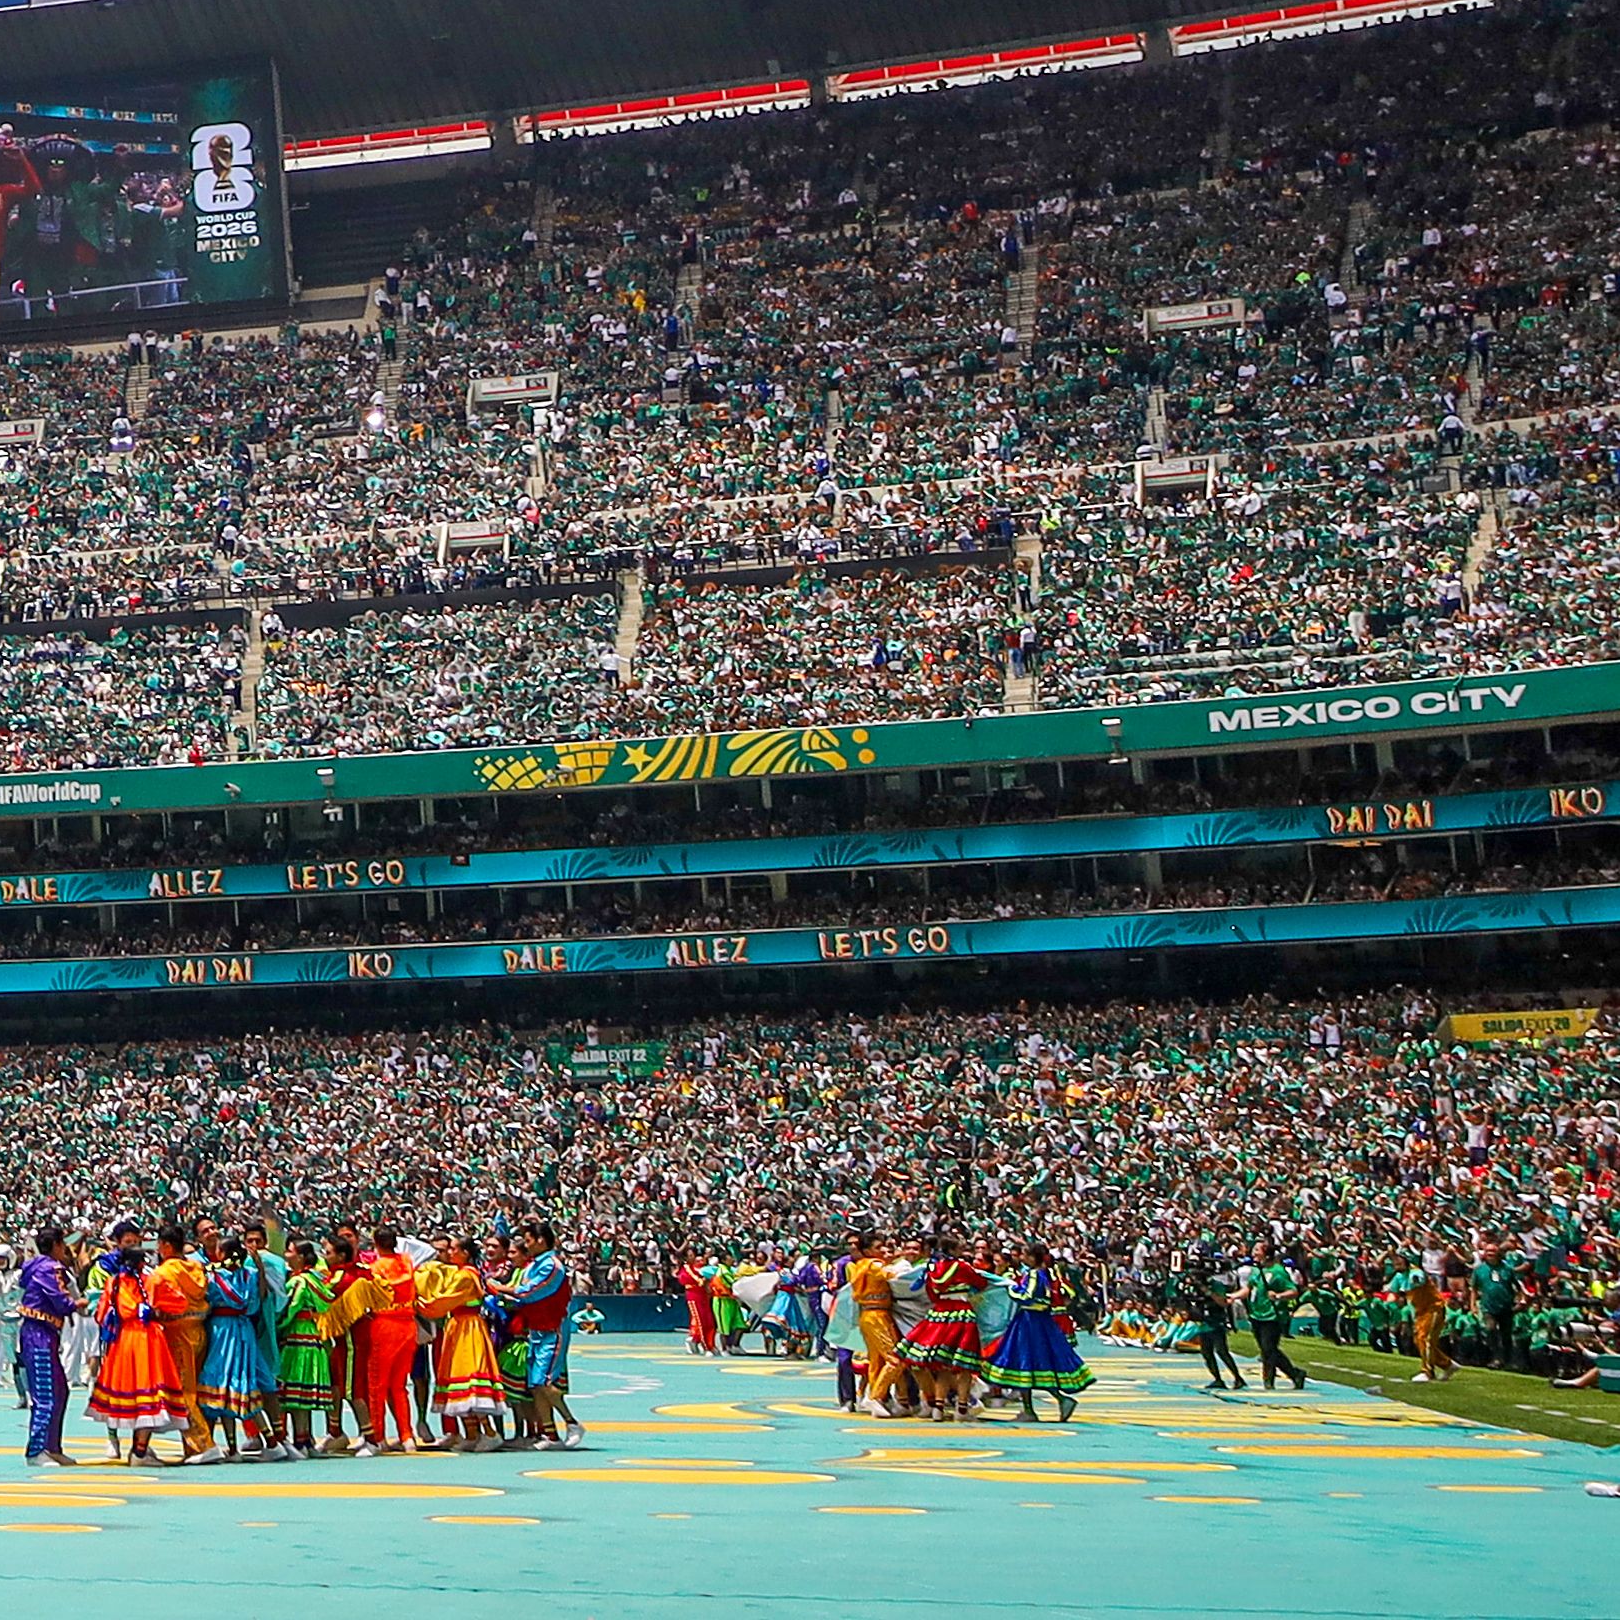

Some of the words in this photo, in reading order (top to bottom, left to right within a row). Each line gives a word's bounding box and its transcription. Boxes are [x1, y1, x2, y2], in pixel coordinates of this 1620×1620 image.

[213, 193, 239, 203] FIFA
[196, 213, 233, 224] WORLD
[235, 211, 256, 221] CUP
[197, 221, 257, 238] 2026
[196, 236, 260, 252] MEXICO
[209, 249, 247, 262] CITY
[1208, 695, 1400, 733] MEXICO
[1410, 683, 1527, 717] CITY
[1549, 787, 1606, 818] IKO
[1326, 805, 1376, 835] DAI
[1383, 800, 1435, 830] DAI
[149, 869, 224, 898] ALLEZ
[287, 860, 359, 891] LET'S
[367, 859, 405, 886] GO
[0, 878, 59, 904] DALE
[665, 936, 749, 968] ALLEZ
[817, 926, 898, 960] LET'S
[907, 926, 949, 954] GO
[166, 959, 206, 985] DAI
[212, 956, 252, 983] DAI
[347, 952, 394, 978] IKO
[503, 946, 568, 974] DALE
[609, 1049, 631, 1061] EXIT
[632, 1049, 647, 1062] 22
